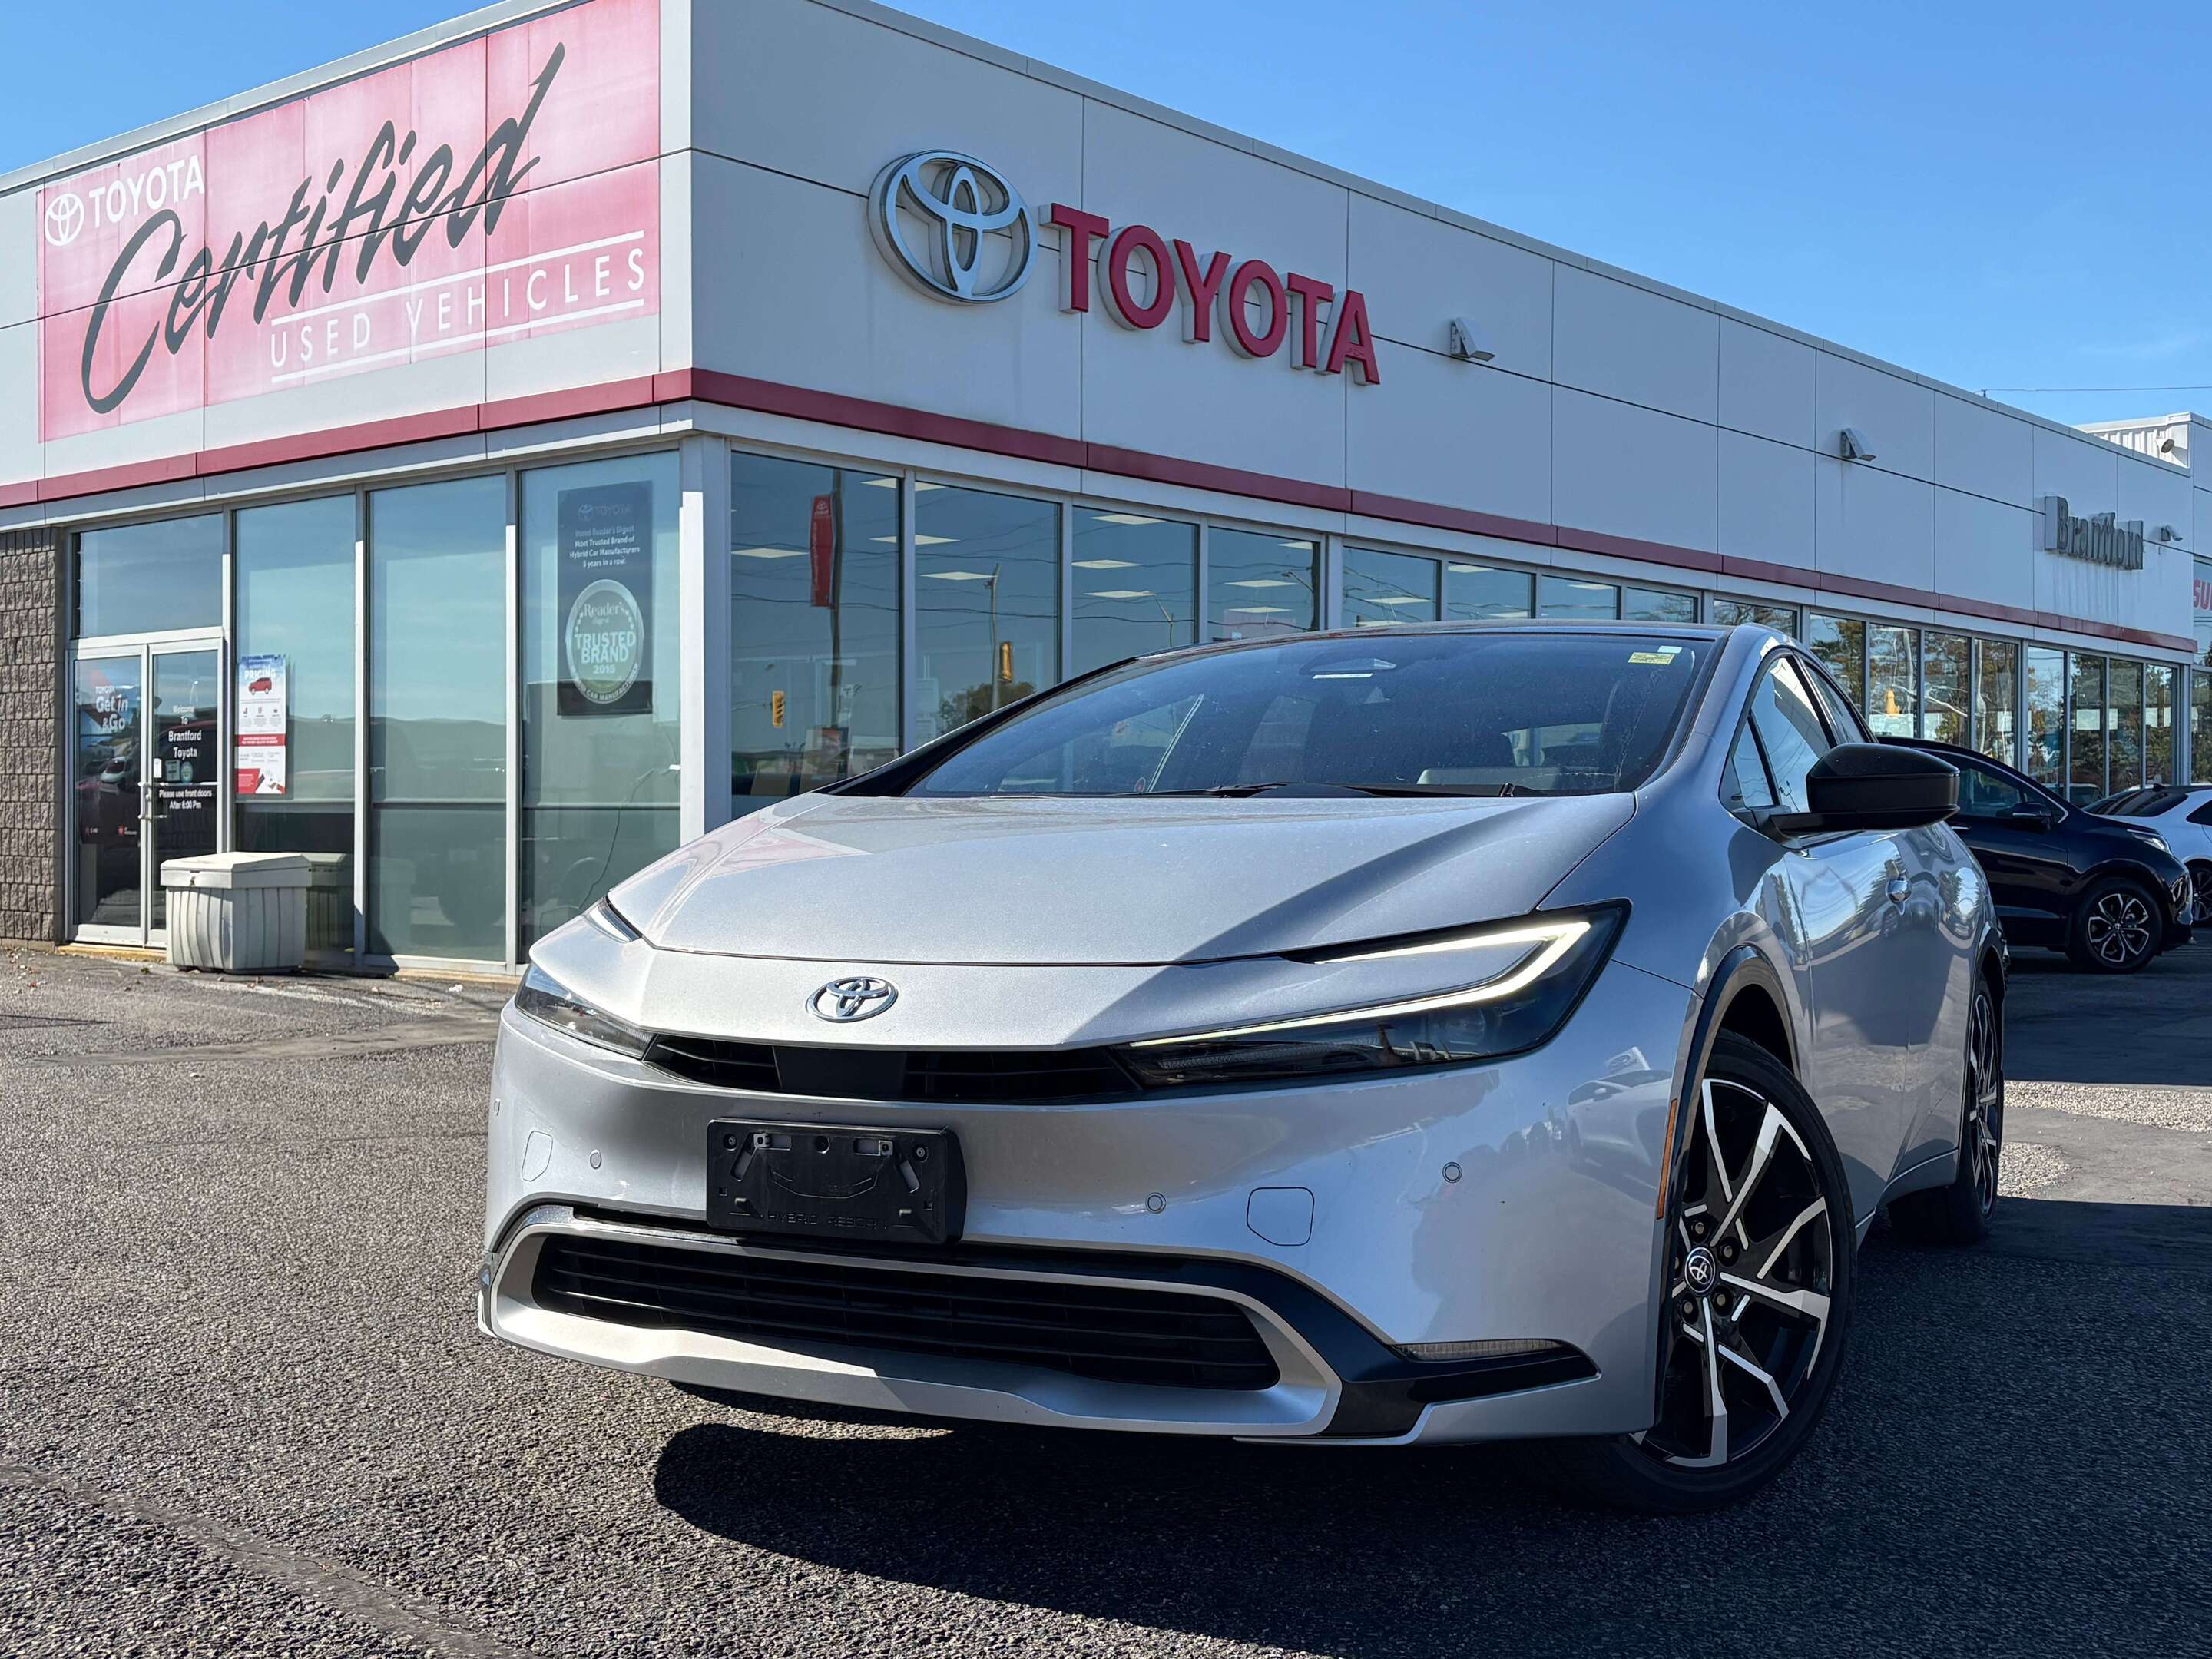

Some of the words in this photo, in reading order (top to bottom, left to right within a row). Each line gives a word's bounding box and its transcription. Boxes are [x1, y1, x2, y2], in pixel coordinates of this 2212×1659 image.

[88, 155, 205, 228] TOYOTA
[81, 41, 565, 415] Certified
[1045, 202, 1381, 386] TOYOTA
[270, 313, 370, 368] USED
[408, 247, 646, 336] VEHICLES
[575, 539, 588, 548] Most
[589, 538, 610, 547] Trusted
[611, 535, 628, 545] Brand
[2044, 495, 2144, 570] Brantford
[569, 550, 588, 560] Hybrid
[588, 548, 599, 557] Car
[599, 546, 641, 556] Manufacturers
[2194, 578, 2212, 611] SU
[574, 631, 637, 650] TRUSTED
[581, 646, 629, 664] BRAND
[96, 695, 117, 713] Get
[180, 716, 189, 725] To
[168, 730, 202, 742] Brantford
[173, 747, 197, 760] Toyota
[197, 788, 213, 797] doors
[169, 800, 181, 810] After
